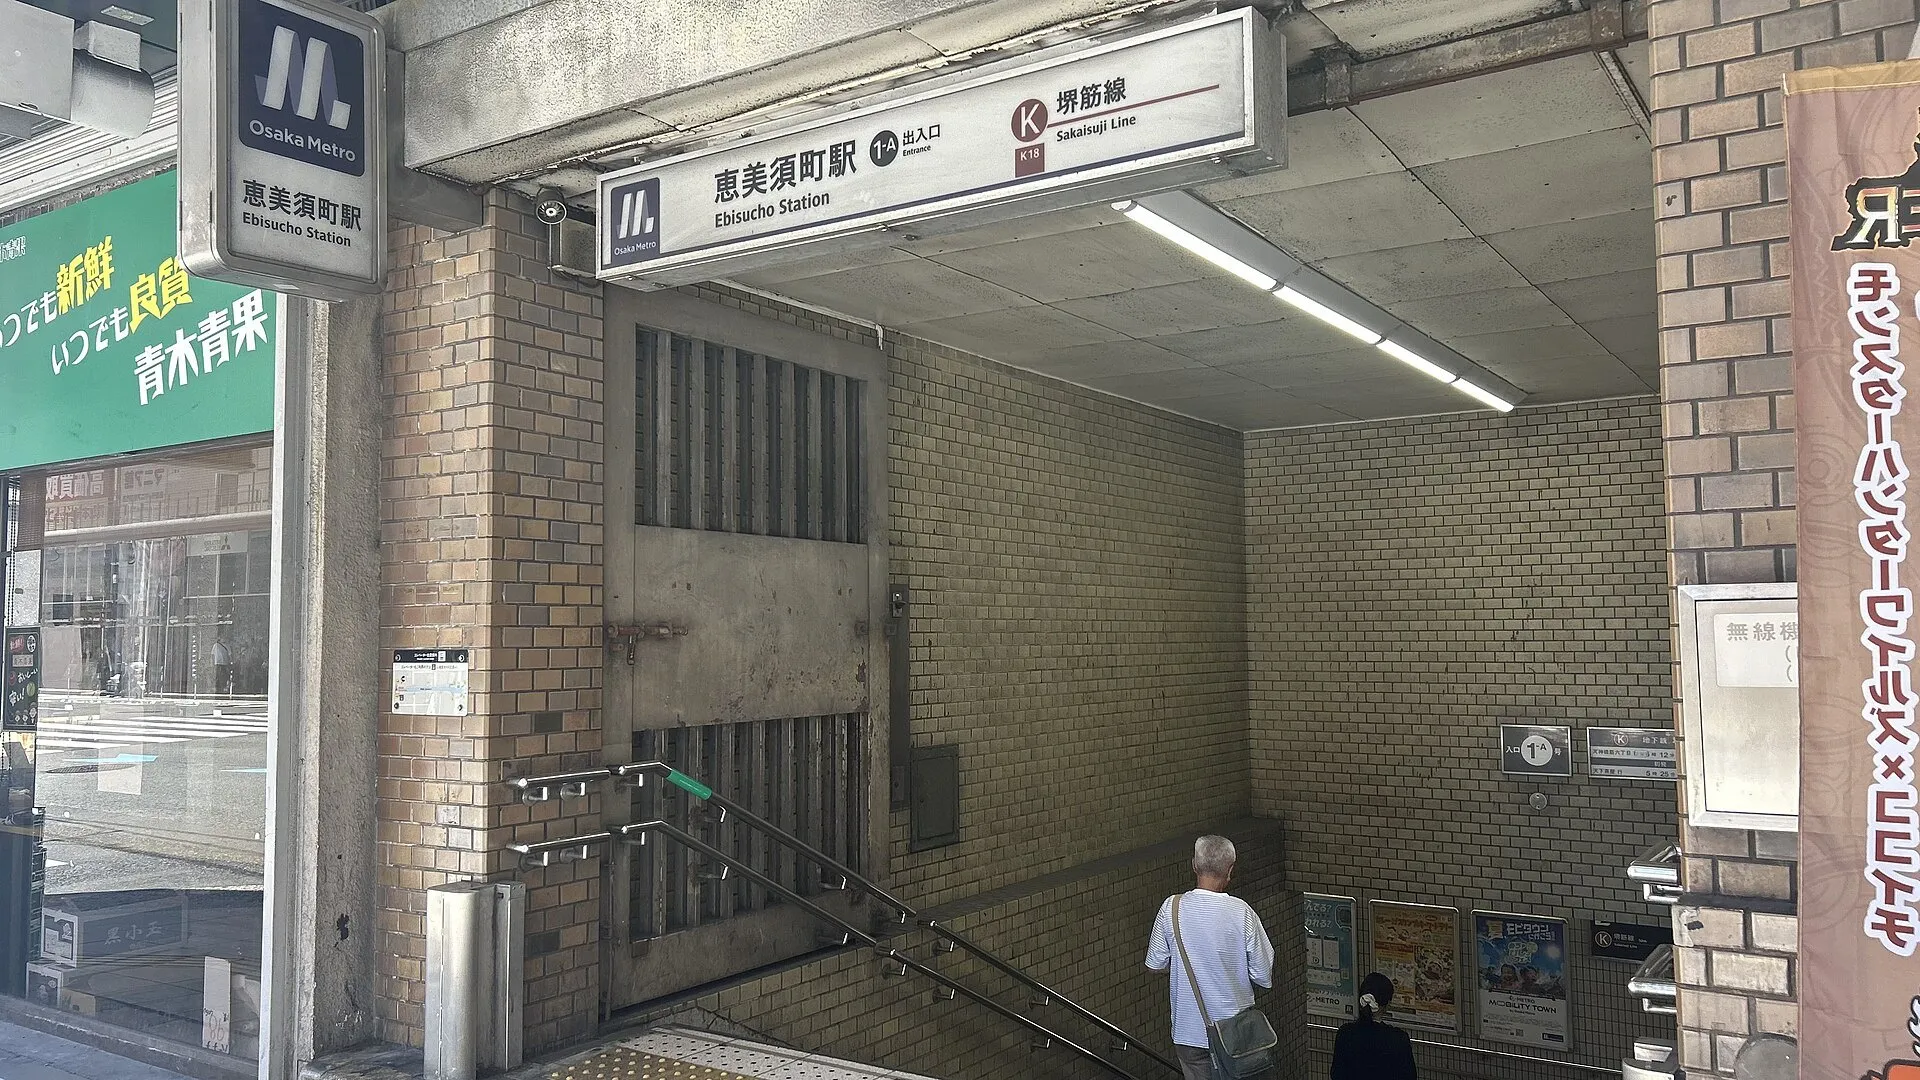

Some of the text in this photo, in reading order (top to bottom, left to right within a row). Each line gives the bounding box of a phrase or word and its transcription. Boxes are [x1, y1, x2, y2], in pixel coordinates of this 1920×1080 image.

[1057, 77, 1127, 115] 堺筋線
[903, 124, 941, 147] 出入口
[1020, 103, 1041, 138] K
[1056, 116, 1137, 142] Sakaisuji Line
[248, 119, 356, 162] Osaka Metro
[902, 145, 932, 157] Entrance
[1019, 148, 1040, 161] K18
[714, 140, 858, 203] 恵美須町駅
[242, 180, 362, 232] 恵美須町駅
[715, 192, 830, 229] Ebisucho Station
[242, 212, 352, 247] Ebisucho Station
[614, 241, 657, 256] Osaka Metro
[0, 236, 115, 348] つでも新鮮
[132, 289, 269, 406] 青木青果
[1505, 745, 1520, 753] 入口
[1617, 735, 1625, 744] K
[1599, 933, 1608, 945] K
[1488, 999, 1530, 1010] MOBILITY
[1532, 1004, 1557, 1014] TOWN
